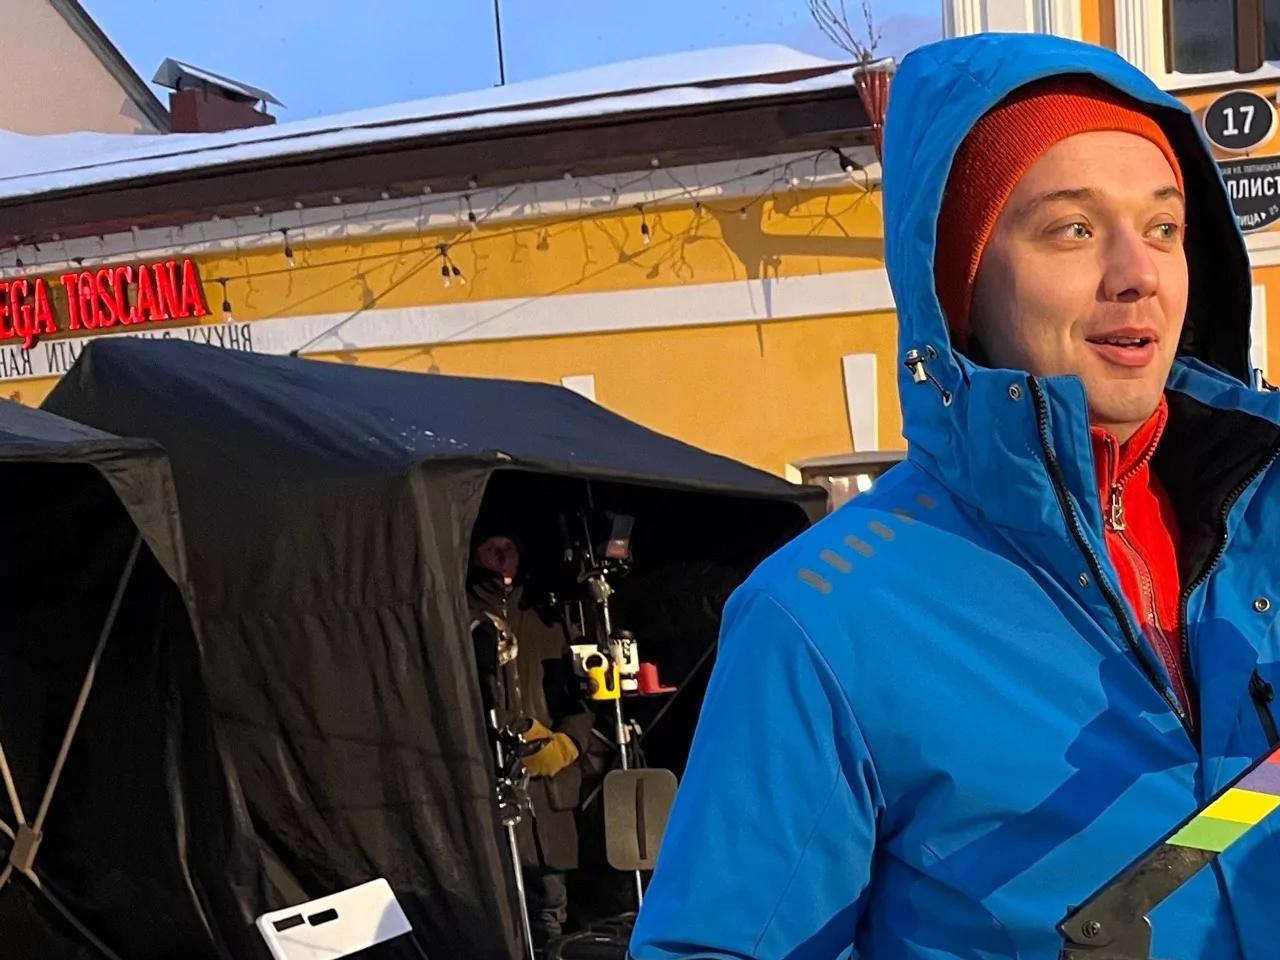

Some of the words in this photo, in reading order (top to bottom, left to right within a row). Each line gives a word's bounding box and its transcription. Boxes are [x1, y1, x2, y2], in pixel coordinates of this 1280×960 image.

[1222, 105, 1255, 137] 17
[0, 278, 57, 349] EGA
[60, 257, 206, 330] TOSCANA
